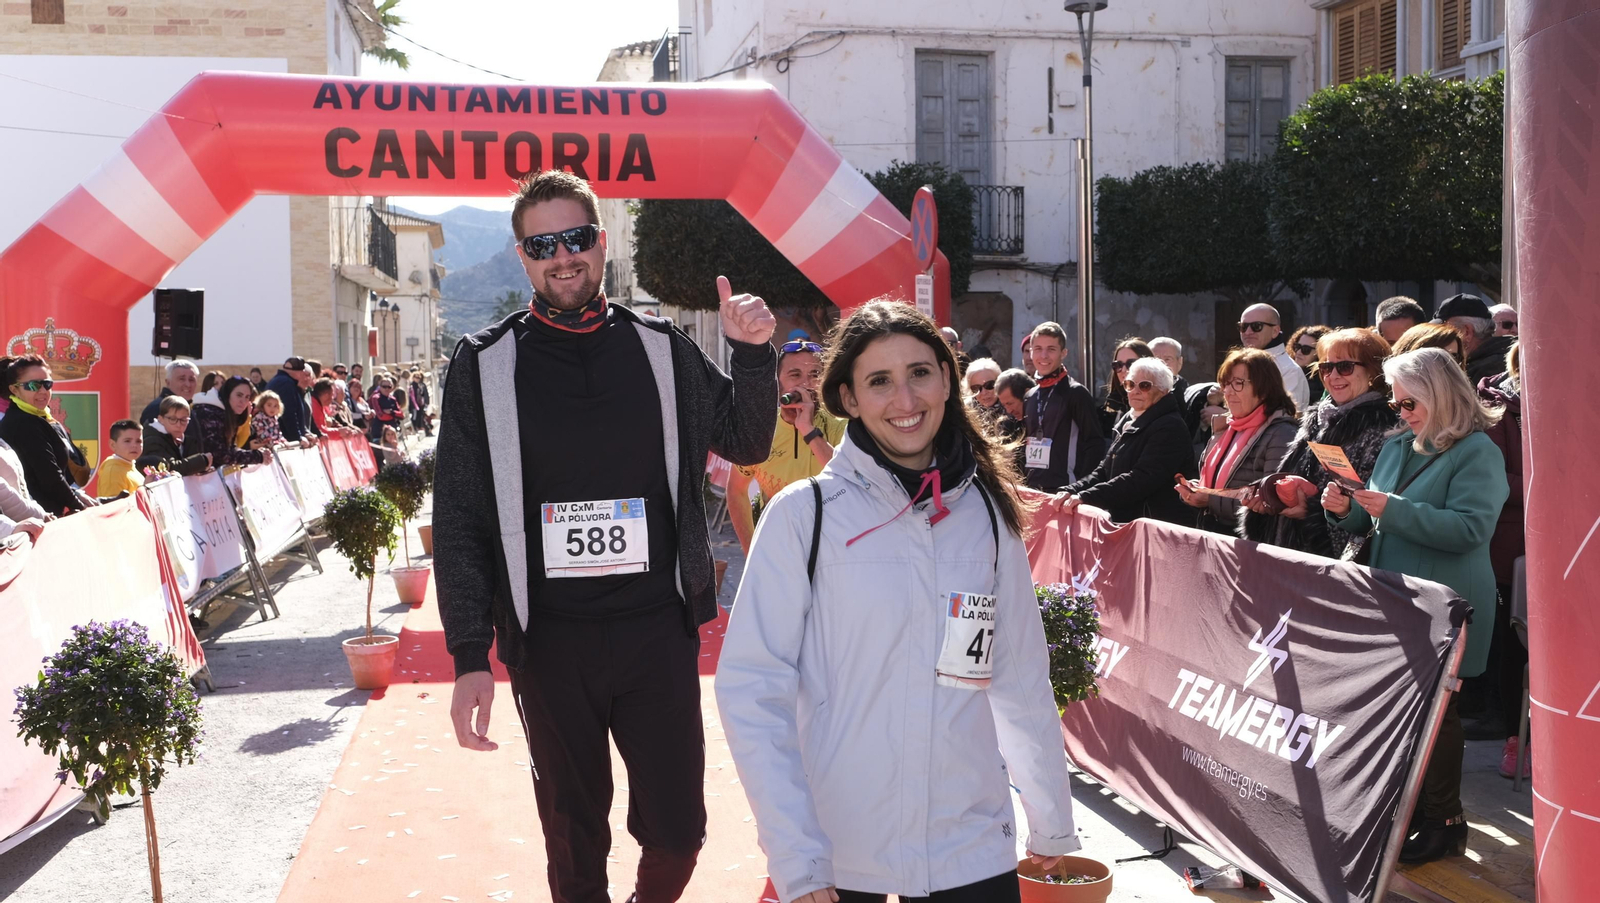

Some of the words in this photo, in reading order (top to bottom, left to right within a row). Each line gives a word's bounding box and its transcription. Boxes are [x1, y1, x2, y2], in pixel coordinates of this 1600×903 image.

[313, 82, 668, 116] AYUNTAMIENTO
[324, 127, 656, 182] CANTORIA
[1029, 447, 1043, 460] 341
[821, 488, 847, 506] RIBORD
[557, 504, 567, 513] IV
[571, 503, 594, 512] CxM
[554, 515, 566, 523] LA
[568, 513, 611, 523] PÓLVORA
[566, 525, 627, 557] 588
[968, 595, 981, 607] IV
[961, 609, 975, 620] LA
[1167, 668, 1347, 769] TEAMERGY
[1182, 745, 1269, 801] www.teamergy.es
